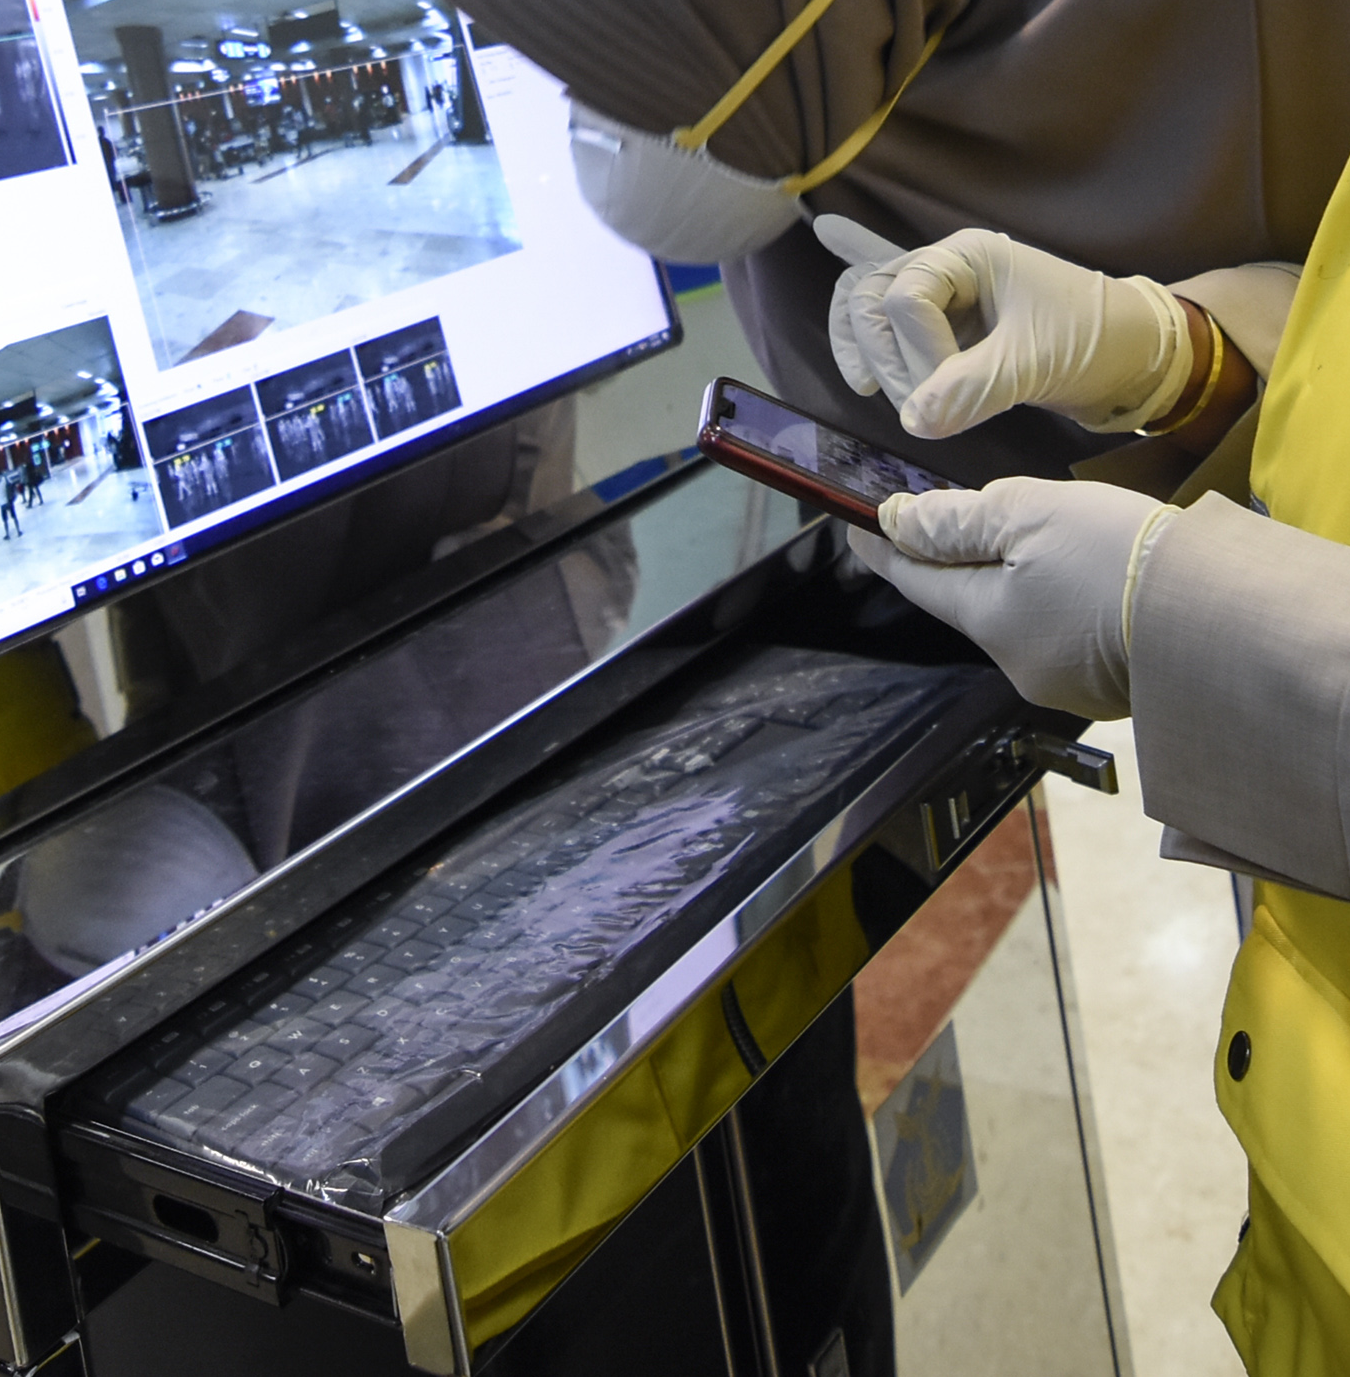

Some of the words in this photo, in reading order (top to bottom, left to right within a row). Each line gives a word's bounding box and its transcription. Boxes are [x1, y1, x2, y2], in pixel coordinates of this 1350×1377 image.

[287, 1029, 304, 1040] W
[338, 1037, 351, 1045] S
[248, 1059, 262, 1069] Q
[299, 1067, 312, 1076] A
